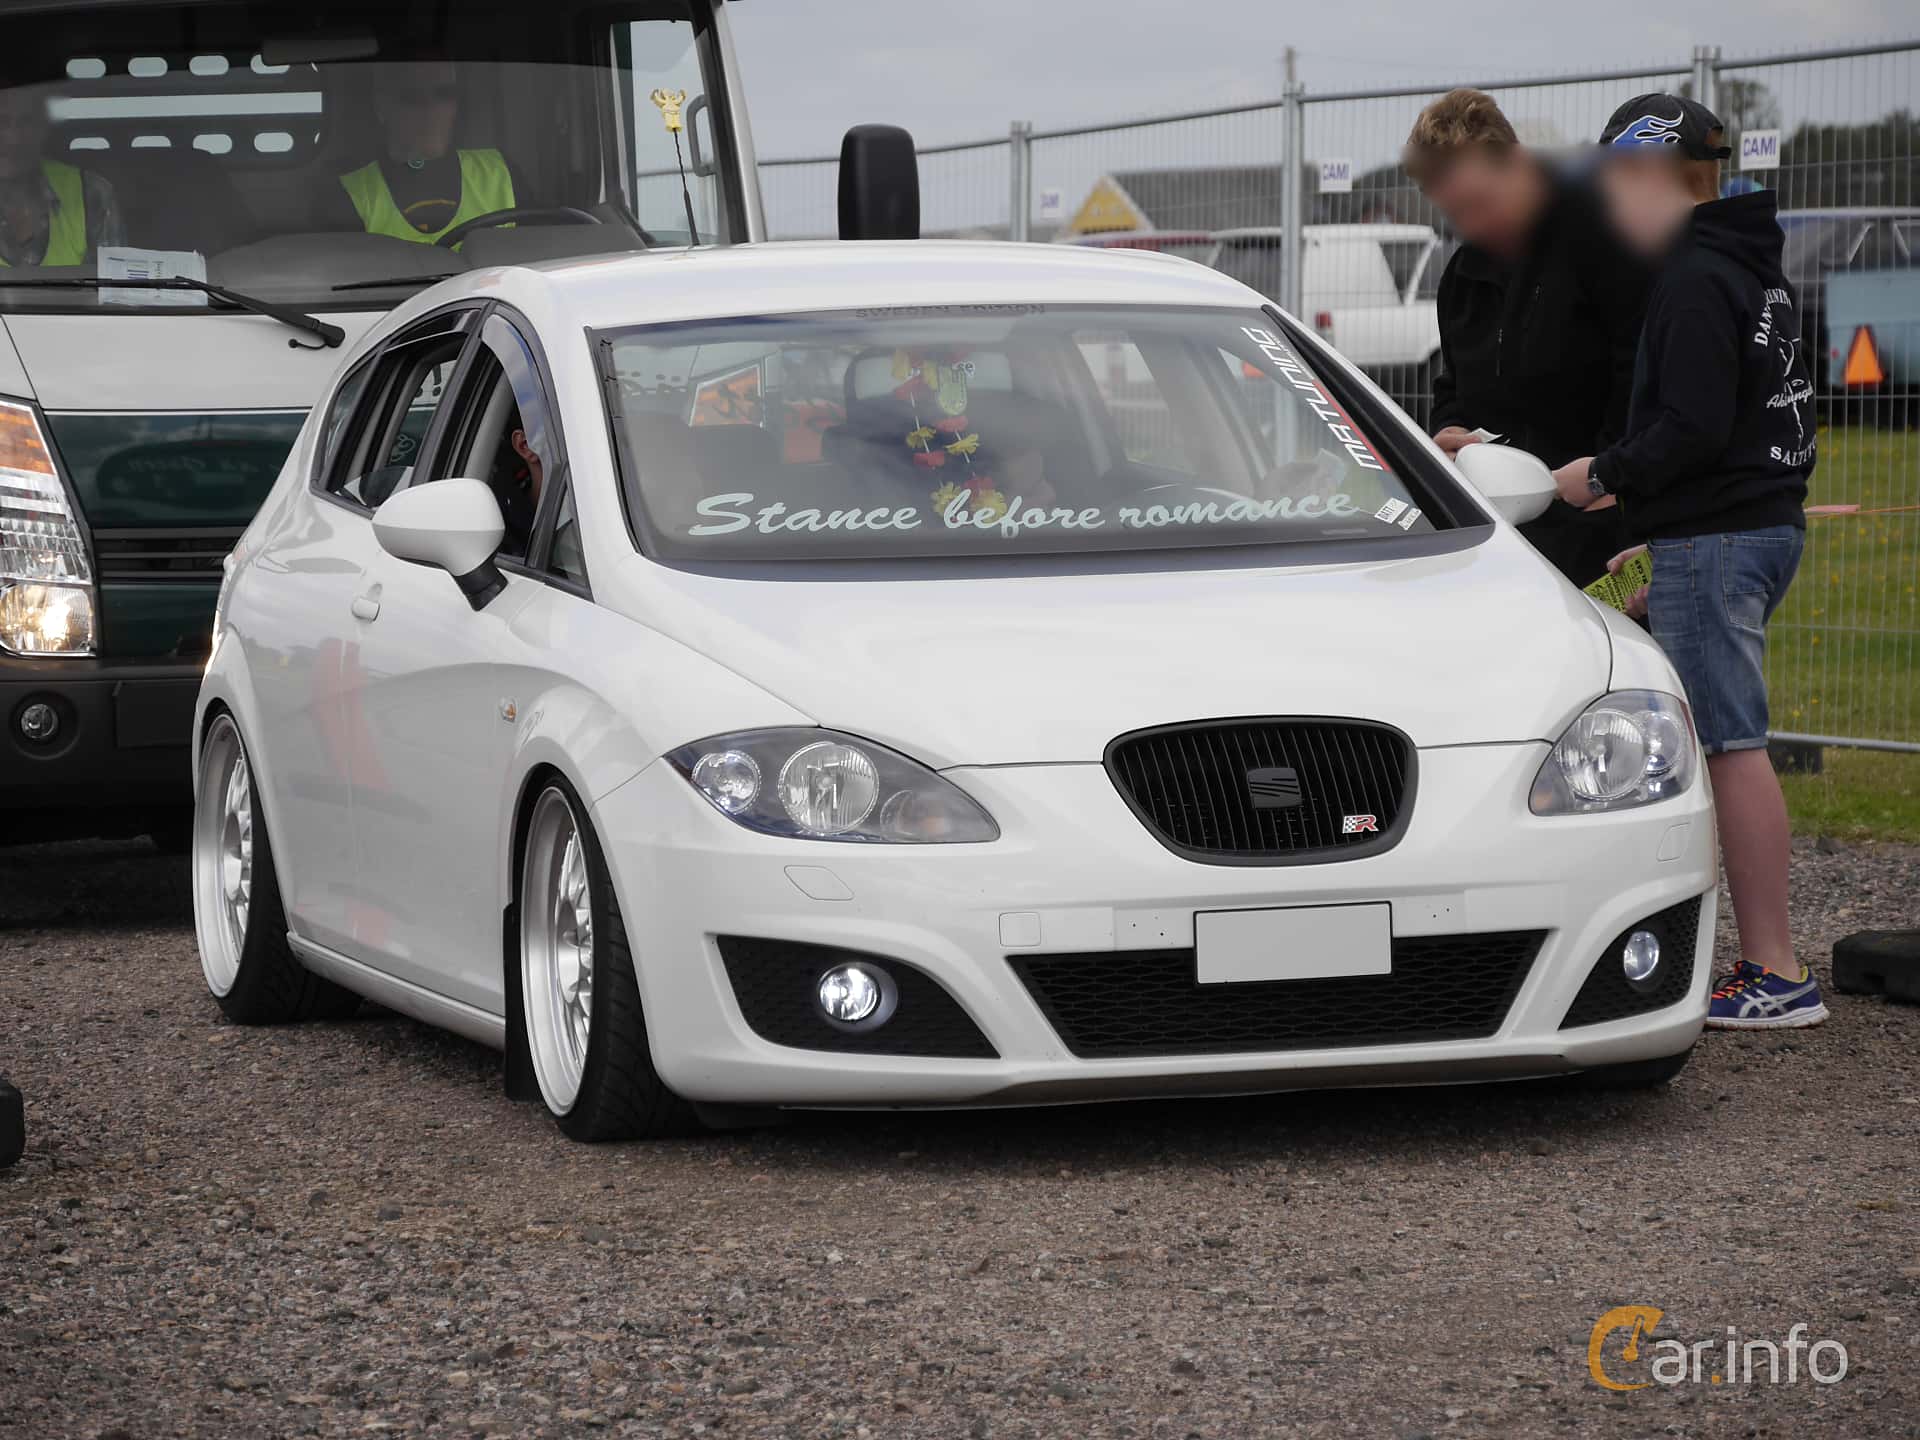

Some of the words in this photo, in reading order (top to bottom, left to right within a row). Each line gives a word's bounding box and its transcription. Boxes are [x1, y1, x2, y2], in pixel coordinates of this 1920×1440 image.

[688, 493, 922, 536] Stance
[944, 488, 1105, 539] before
[1119, 493, 1360, 529] romance
